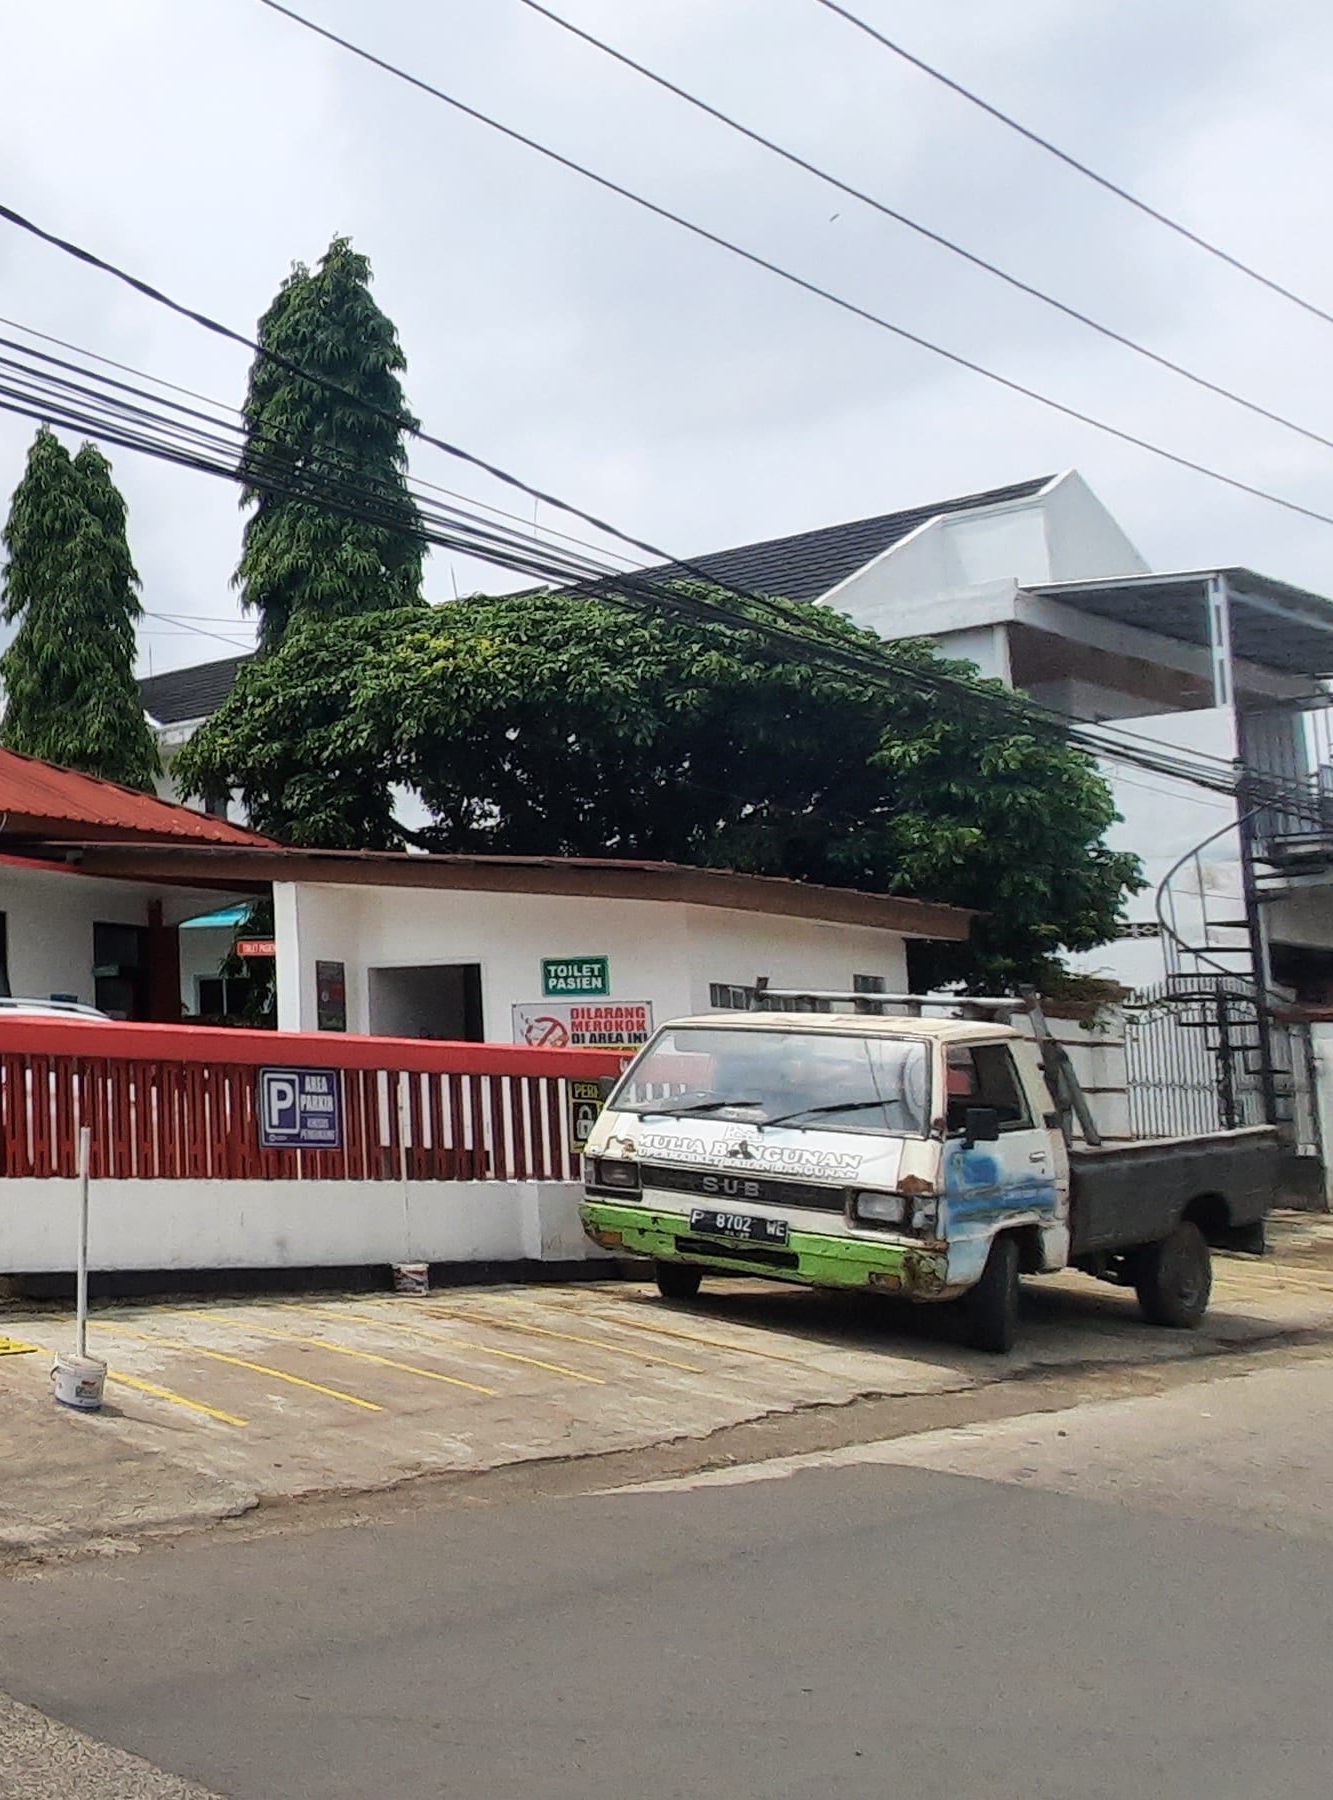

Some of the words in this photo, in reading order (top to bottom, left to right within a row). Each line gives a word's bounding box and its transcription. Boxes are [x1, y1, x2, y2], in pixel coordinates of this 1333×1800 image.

[547, 964, 601, 977] TOILET
[548, 977, 602, 990] PASIEN
[570, 1006, 646, 1020] DILARANG
[570, 1019, 647, 1033] MEROKOK
[571, 1032, 584, 1044] DI
[589, 1032, 621, 1044] AREA
[270, 1081, 294, 1126] P
[638, 1134, 705, 1156] MULIA
[691, 1210, 705, 1224] P
[715, 1213, 752, 1233] 8702
[765, 1220, 786, 1237] WE
